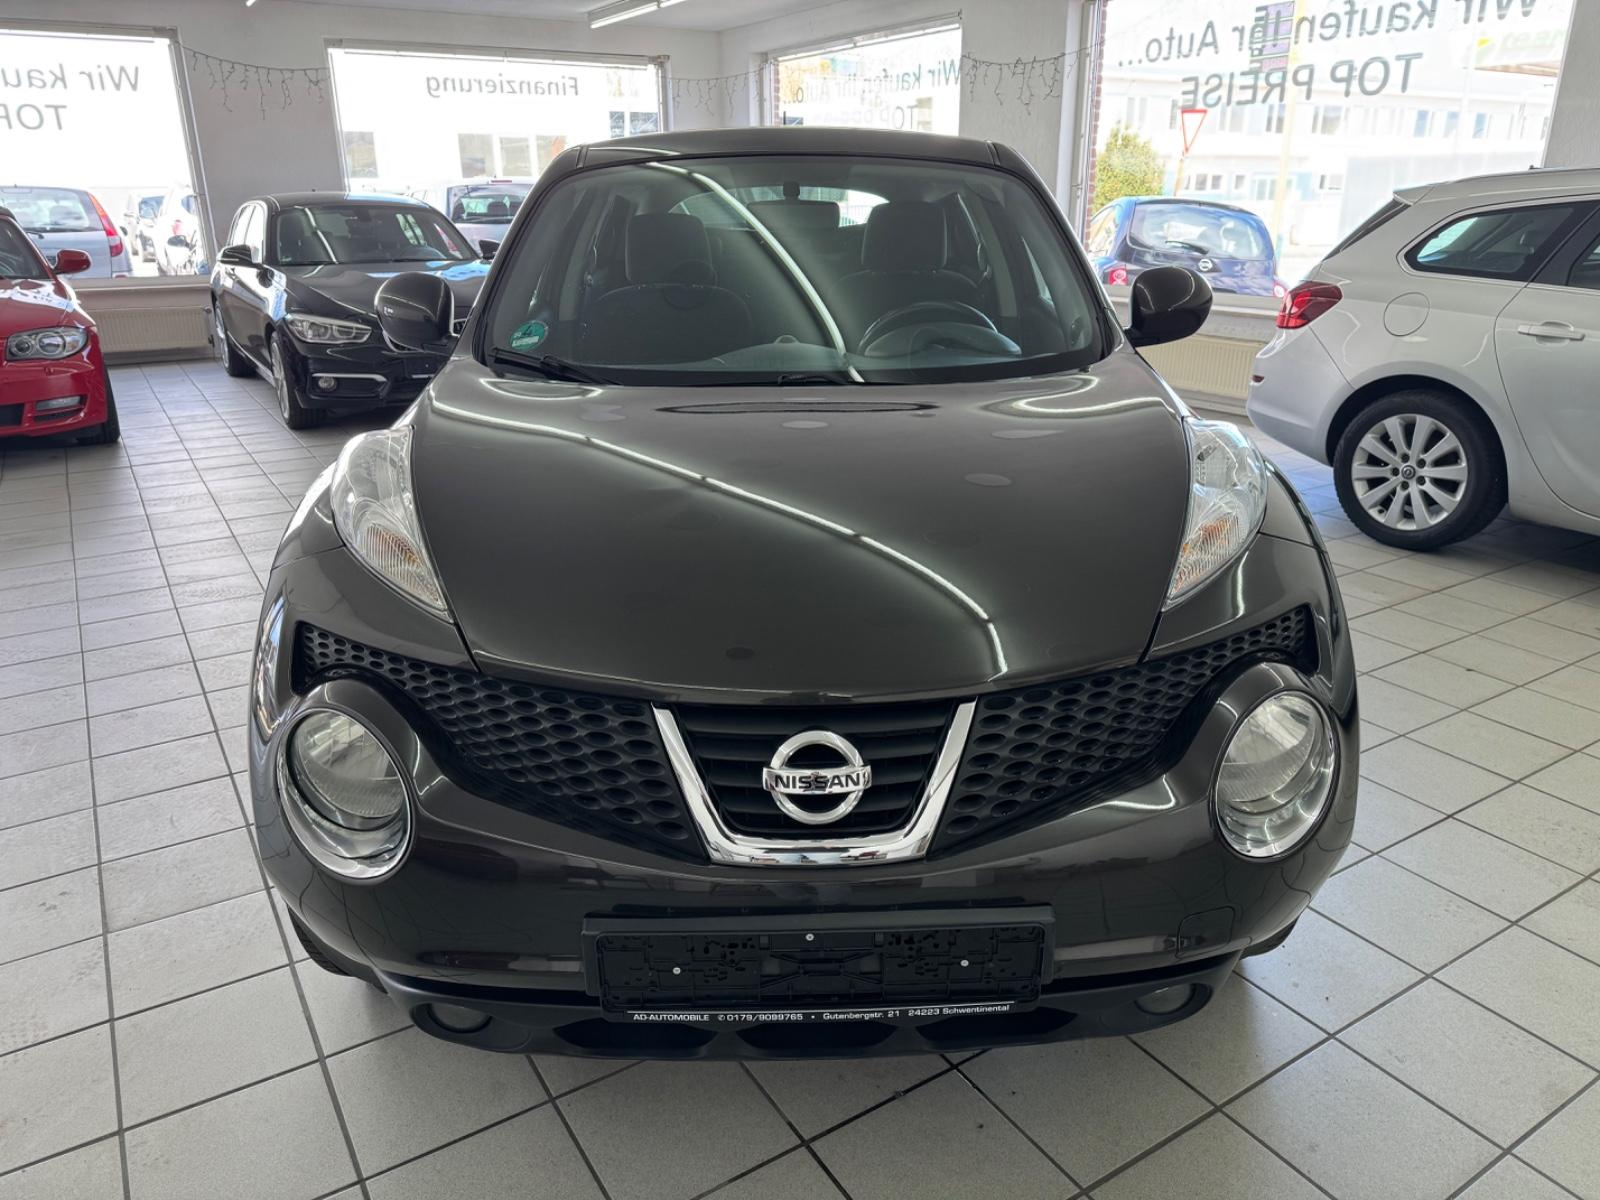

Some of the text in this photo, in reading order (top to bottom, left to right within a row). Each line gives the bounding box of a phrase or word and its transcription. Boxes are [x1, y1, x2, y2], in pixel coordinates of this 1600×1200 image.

[774, 771, 861, 791] NISSAN
[633, 1013, 710, 1022] AD-AUTOMOBILE
[822, 1011, 885, 1021] Gutenbergstr.
[887, 1010, 900, 1018] 21
[907, 1008, 940, 1017] 24223
[942, 1004, 1011, 1015] Schwentinental
